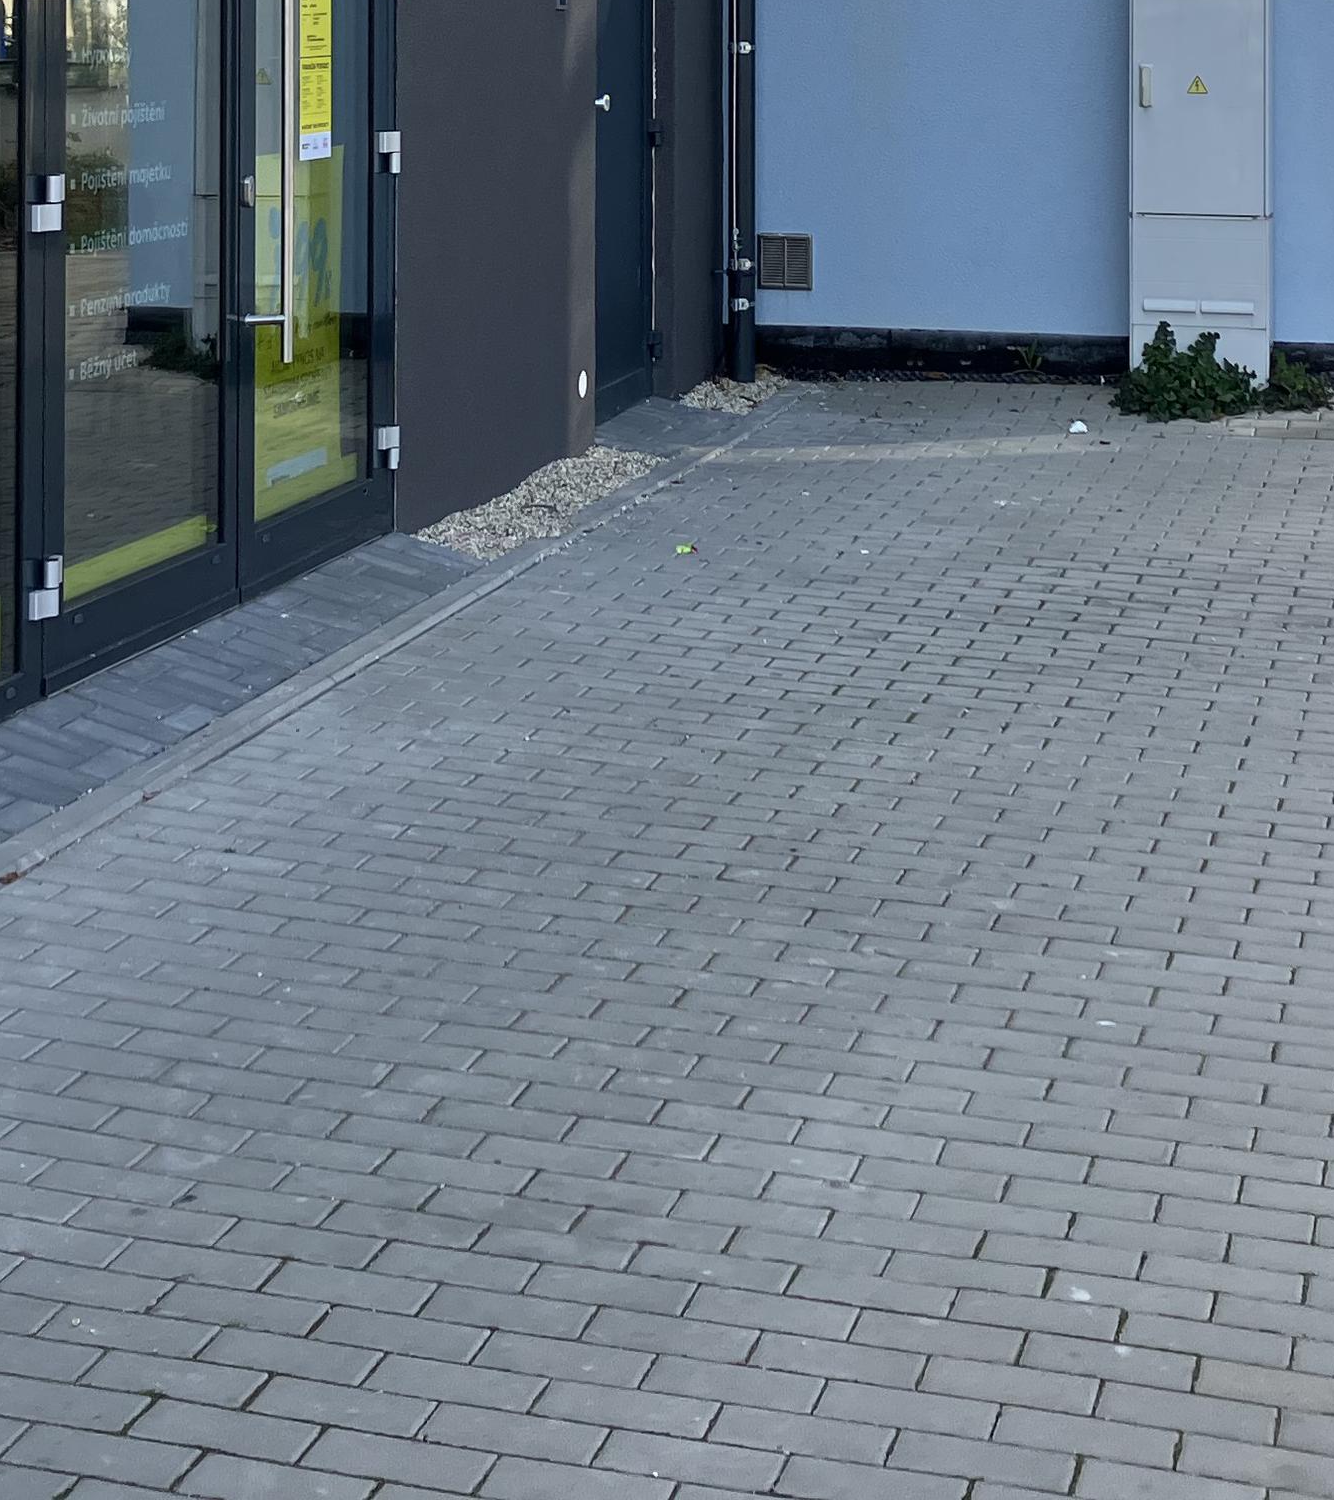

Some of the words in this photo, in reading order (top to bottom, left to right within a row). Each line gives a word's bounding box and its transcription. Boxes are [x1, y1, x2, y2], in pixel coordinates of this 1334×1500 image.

[81, 103, 119, 128] Životní
[120, 100, 166, 129] pojištění
[81, 166, 127, 196] Pojištění
[128, 161, 172, 189] majetku
[80, 225, 127, 258] Pojištění
[128, 216, 188, 246] domácnosti
[124, 281, 172, 310] produkty
[79, 353, 112, 382] Běžný
[114, 348, 139, 372] účet
